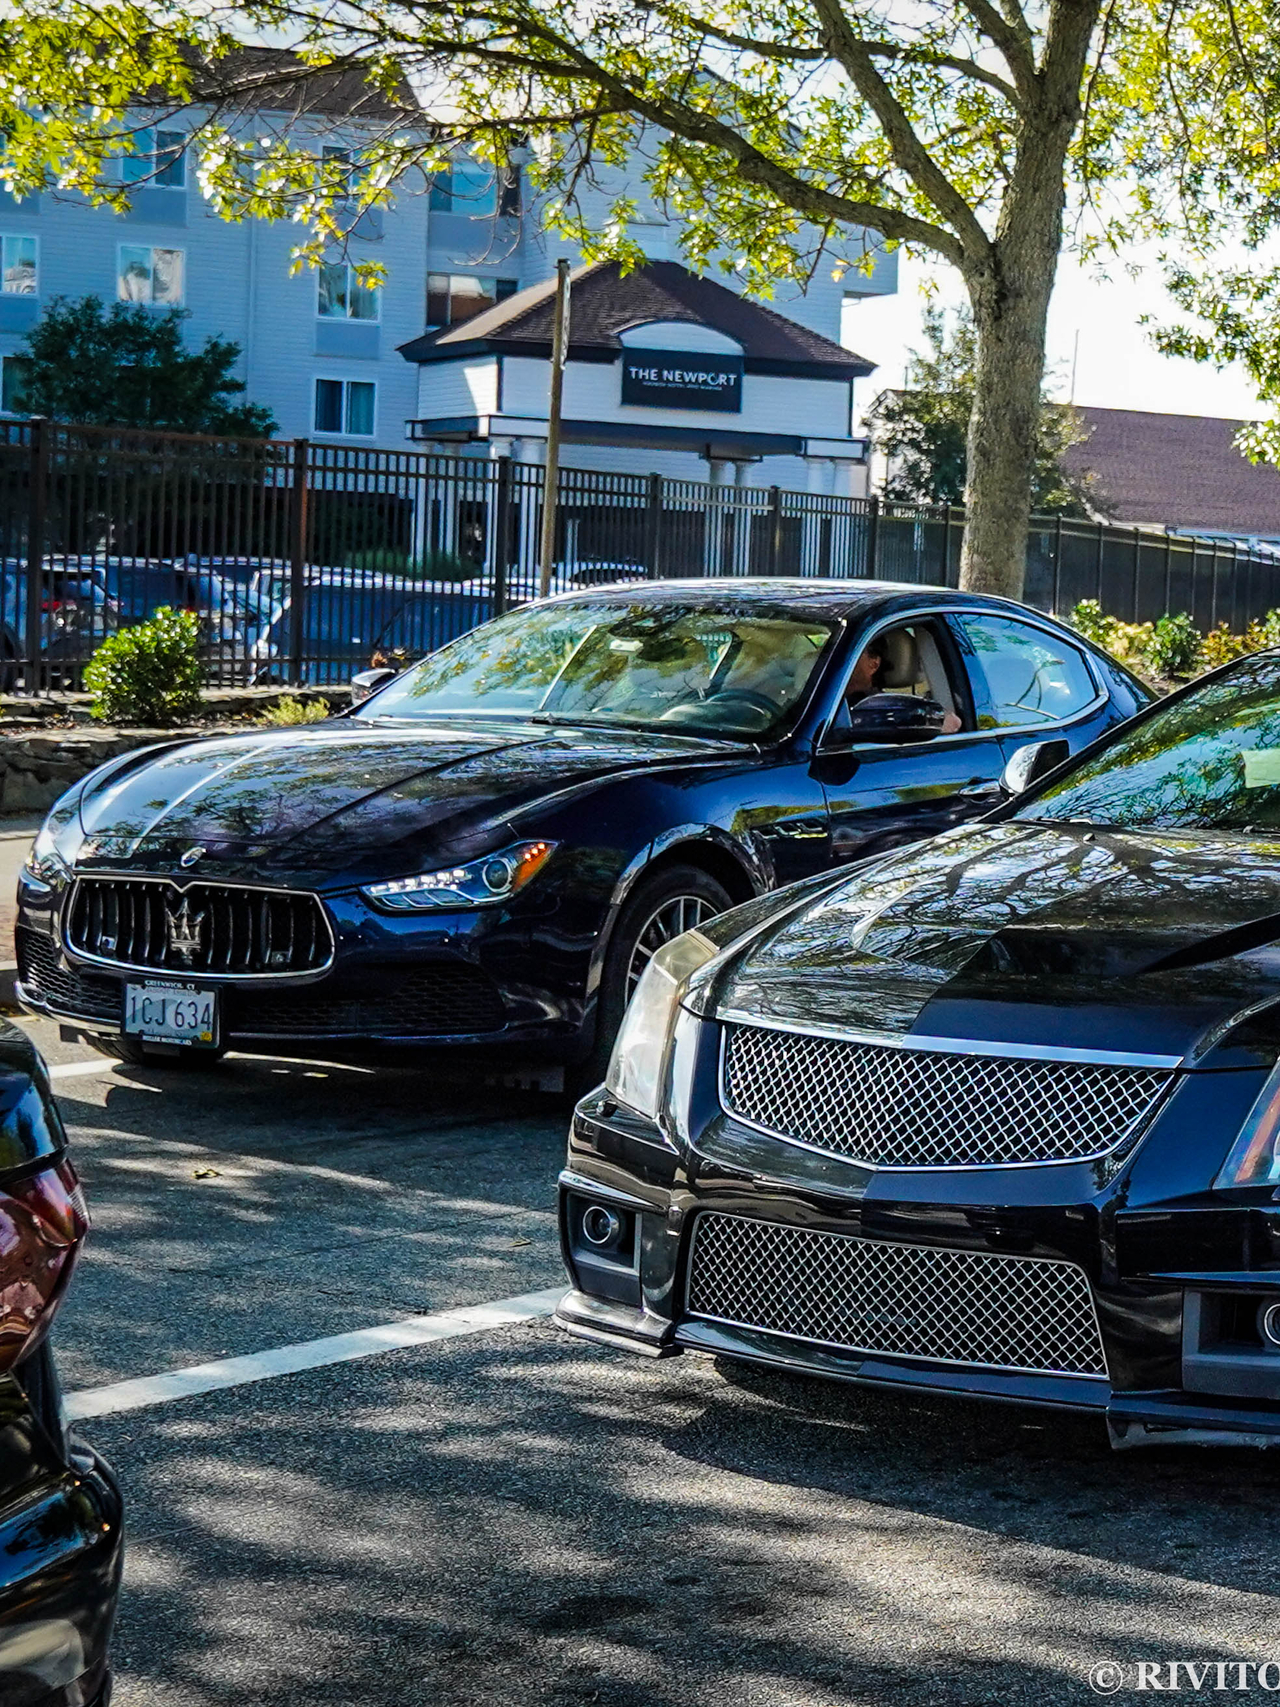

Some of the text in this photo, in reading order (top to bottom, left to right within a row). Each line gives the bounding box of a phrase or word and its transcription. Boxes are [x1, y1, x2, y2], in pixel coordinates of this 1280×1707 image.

[629, 366, 658, 380] THE
[663, 370, 737, 386] NEWPORT
[131, 995, 212, 1031] 1CJ 634
